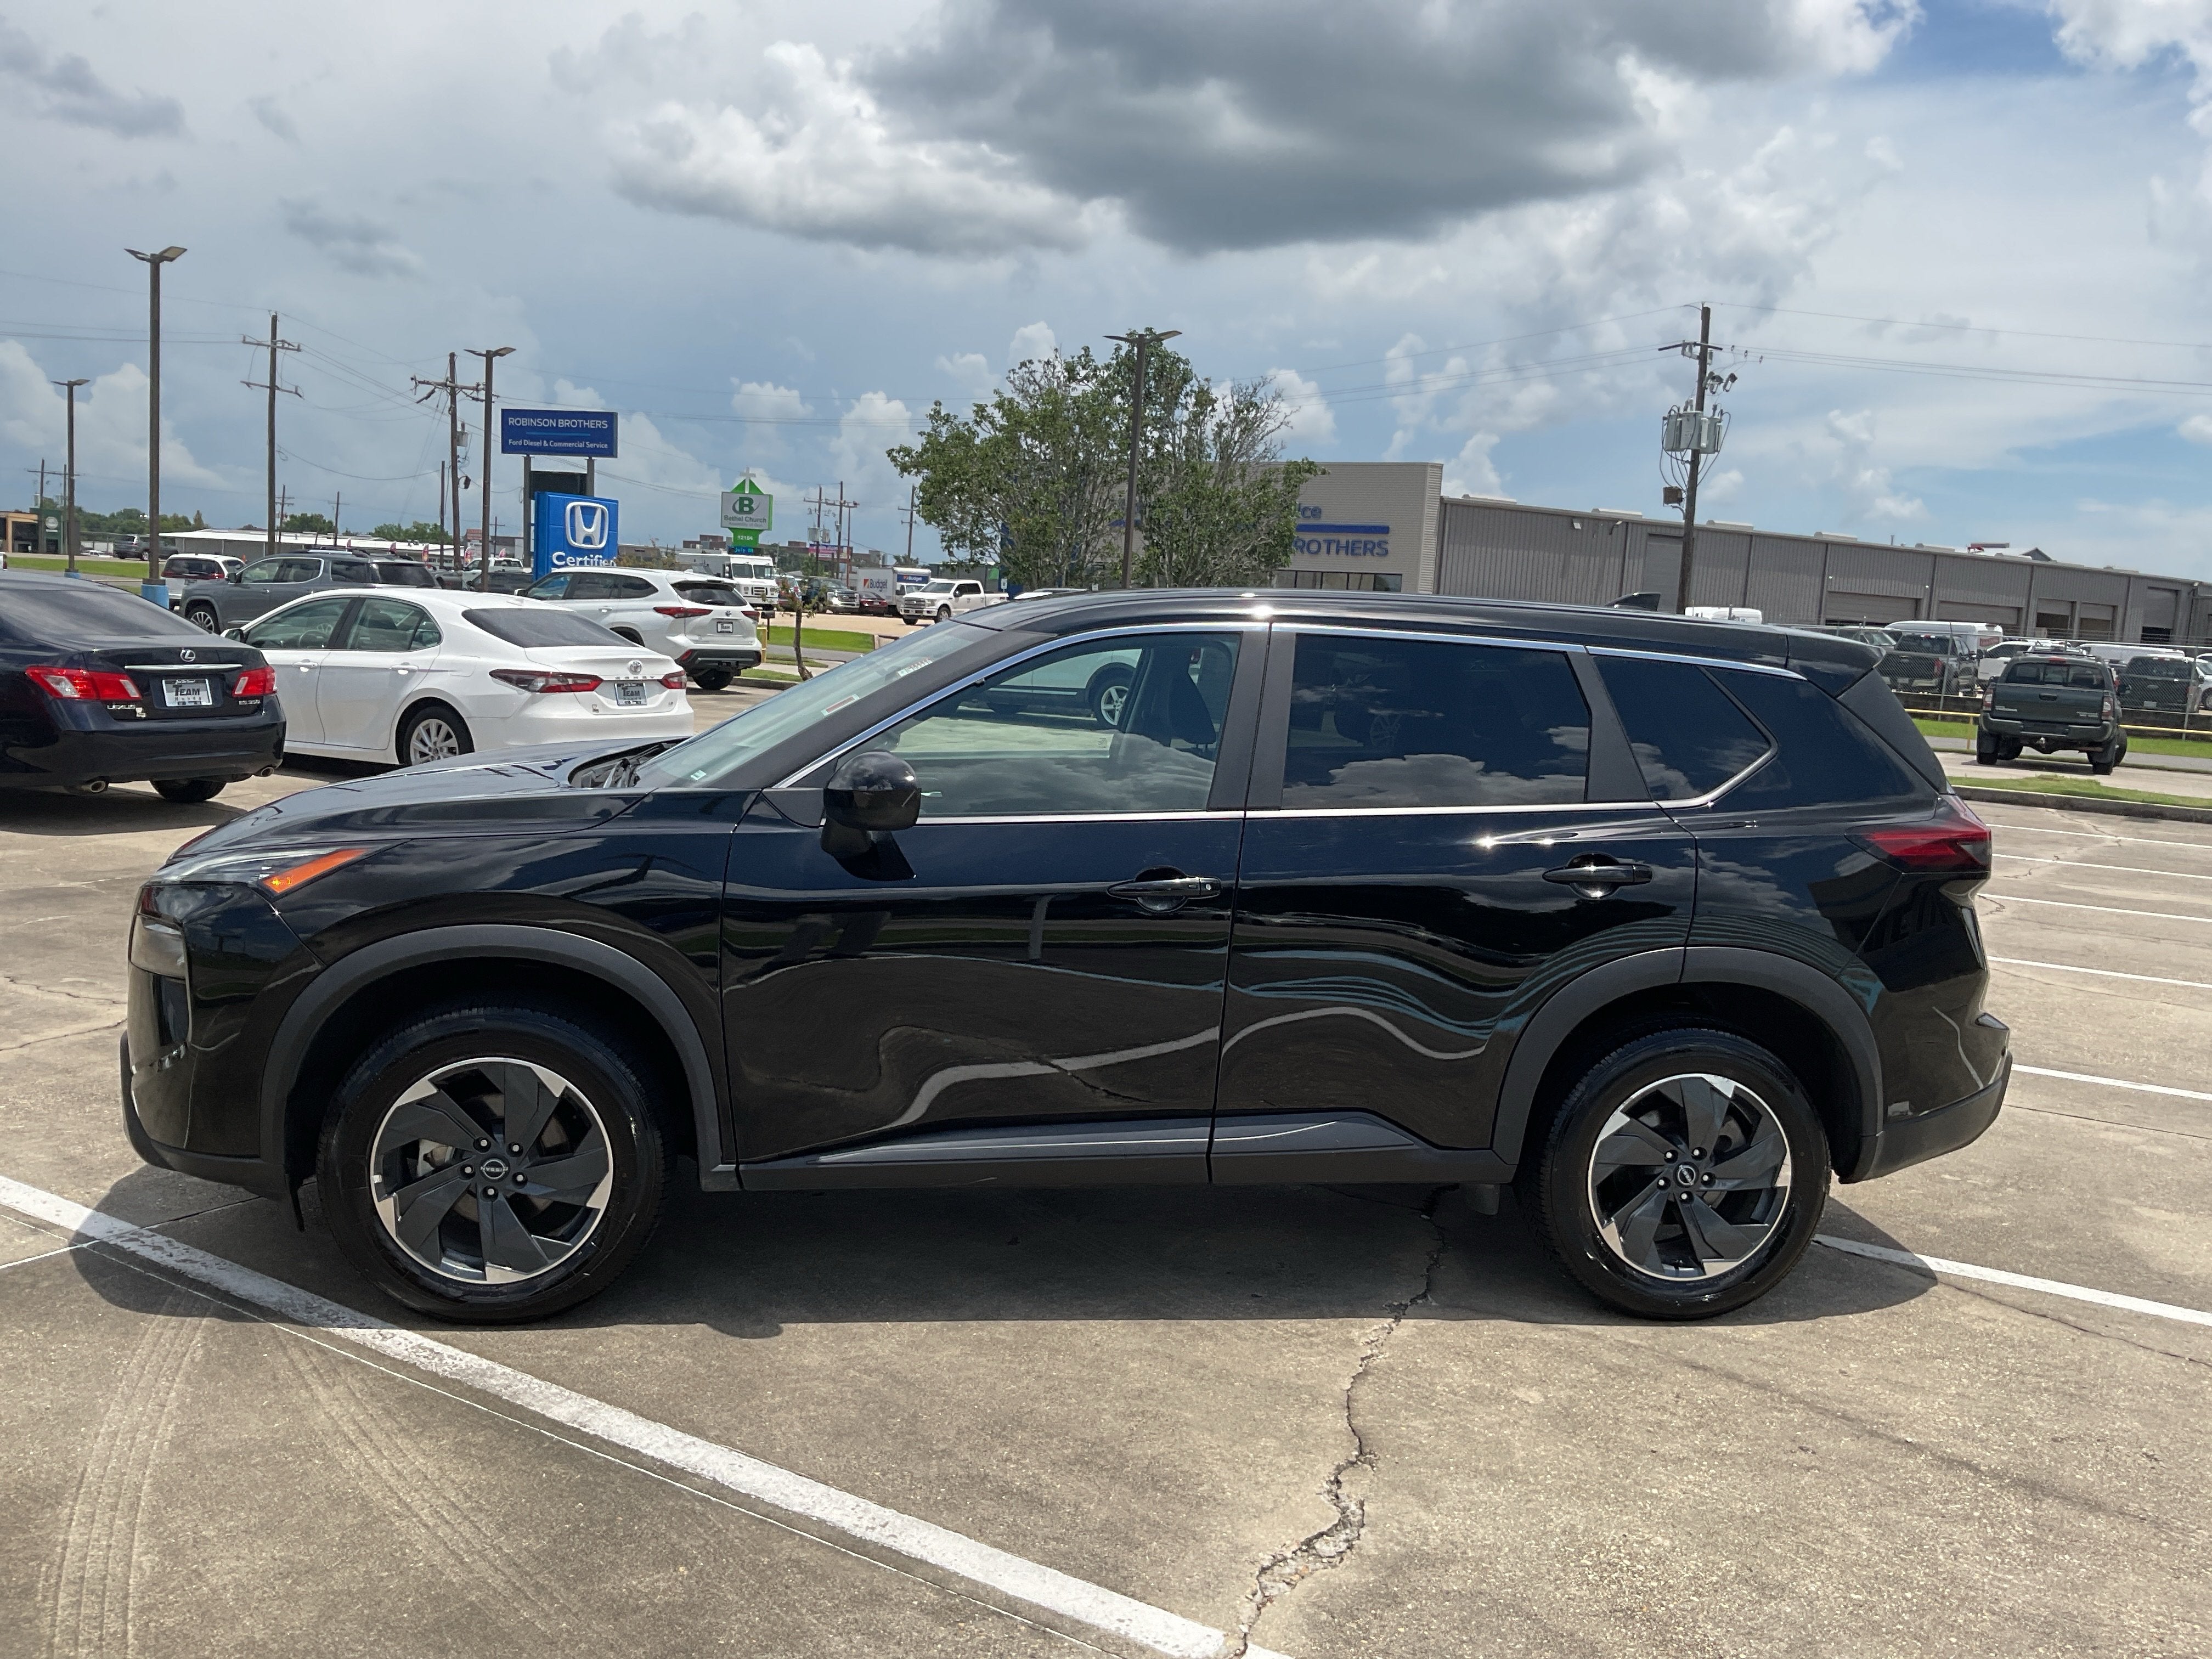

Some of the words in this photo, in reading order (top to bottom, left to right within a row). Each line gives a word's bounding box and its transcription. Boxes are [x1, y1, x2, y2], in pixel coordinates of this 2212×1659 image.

[509, 417, 556, 427] ROBINSON
[558, 419, 608, 429] BROTHERS
[1293, 538, 1389, 556] ROTHERS
[870, 578, 888, 592] Budget
[172, 684, 200, 696] TEAM
[622, 687, 640, 697] TEAM
